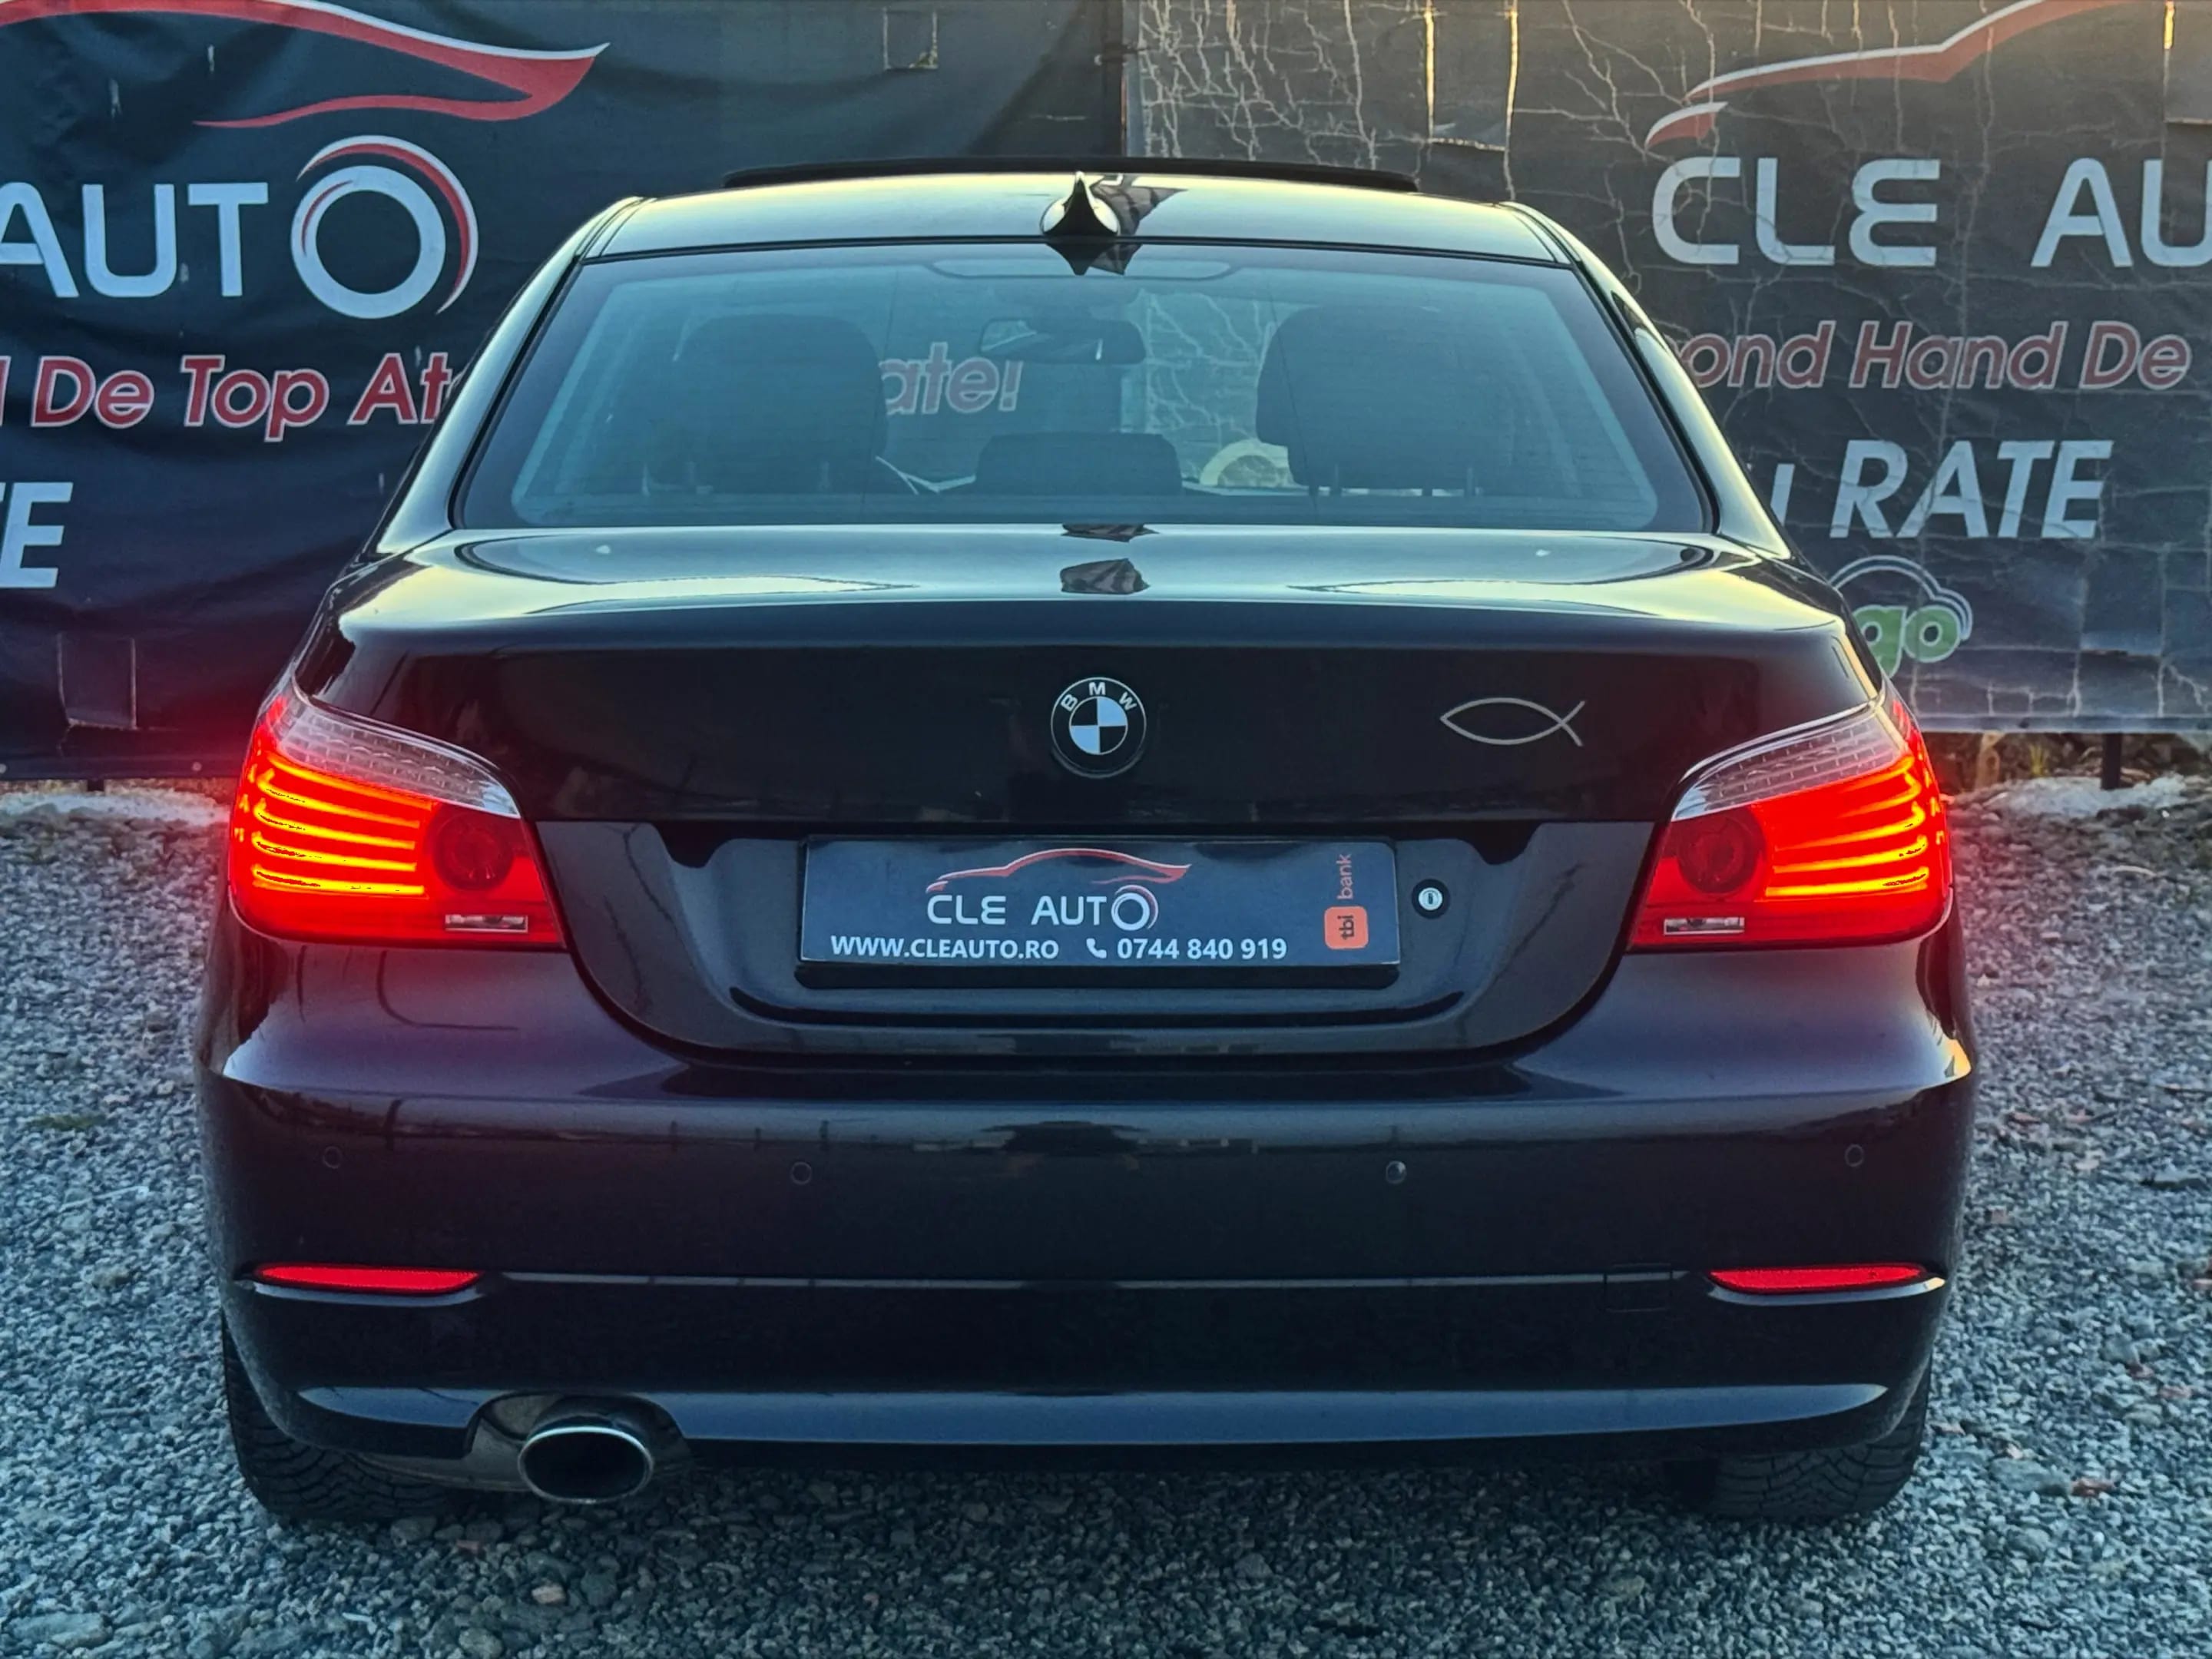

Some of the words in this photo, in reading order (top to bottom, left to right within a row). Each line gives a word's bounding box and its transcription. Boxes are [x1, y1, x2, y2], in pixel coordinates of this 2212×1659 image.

[1651, 157, 1940, 267] CLE
[0, 165, 445, 319] AUTO
[1664, 320, 1836, 389] ond
[1849, 320, 2068, 390] Hand
[2079, 321, 2192, 392] De
[31, 356, 155, 429] De
[181, 355, 329, 442] Top
[346, 352, 459, 425] At
[1830, 440, 2114, 538] RATE
[0, 482, 74, 588] E
[1060, 681, 1137, 712] BMW
[1336, 853, 1353, 900] bank
[927, 895, 1007, 925] CLE
[1031, 891, 1151, 932] AUTO
[1337, 914, 1356, 941] tbi
[830, 935, 1060, 959] WWW.CLEAUTO.RO
[1117, 938, 1180, 960] 0744
[1187, 938, 1233, 960] 840
[1240, 938, 1288, 960] 919
